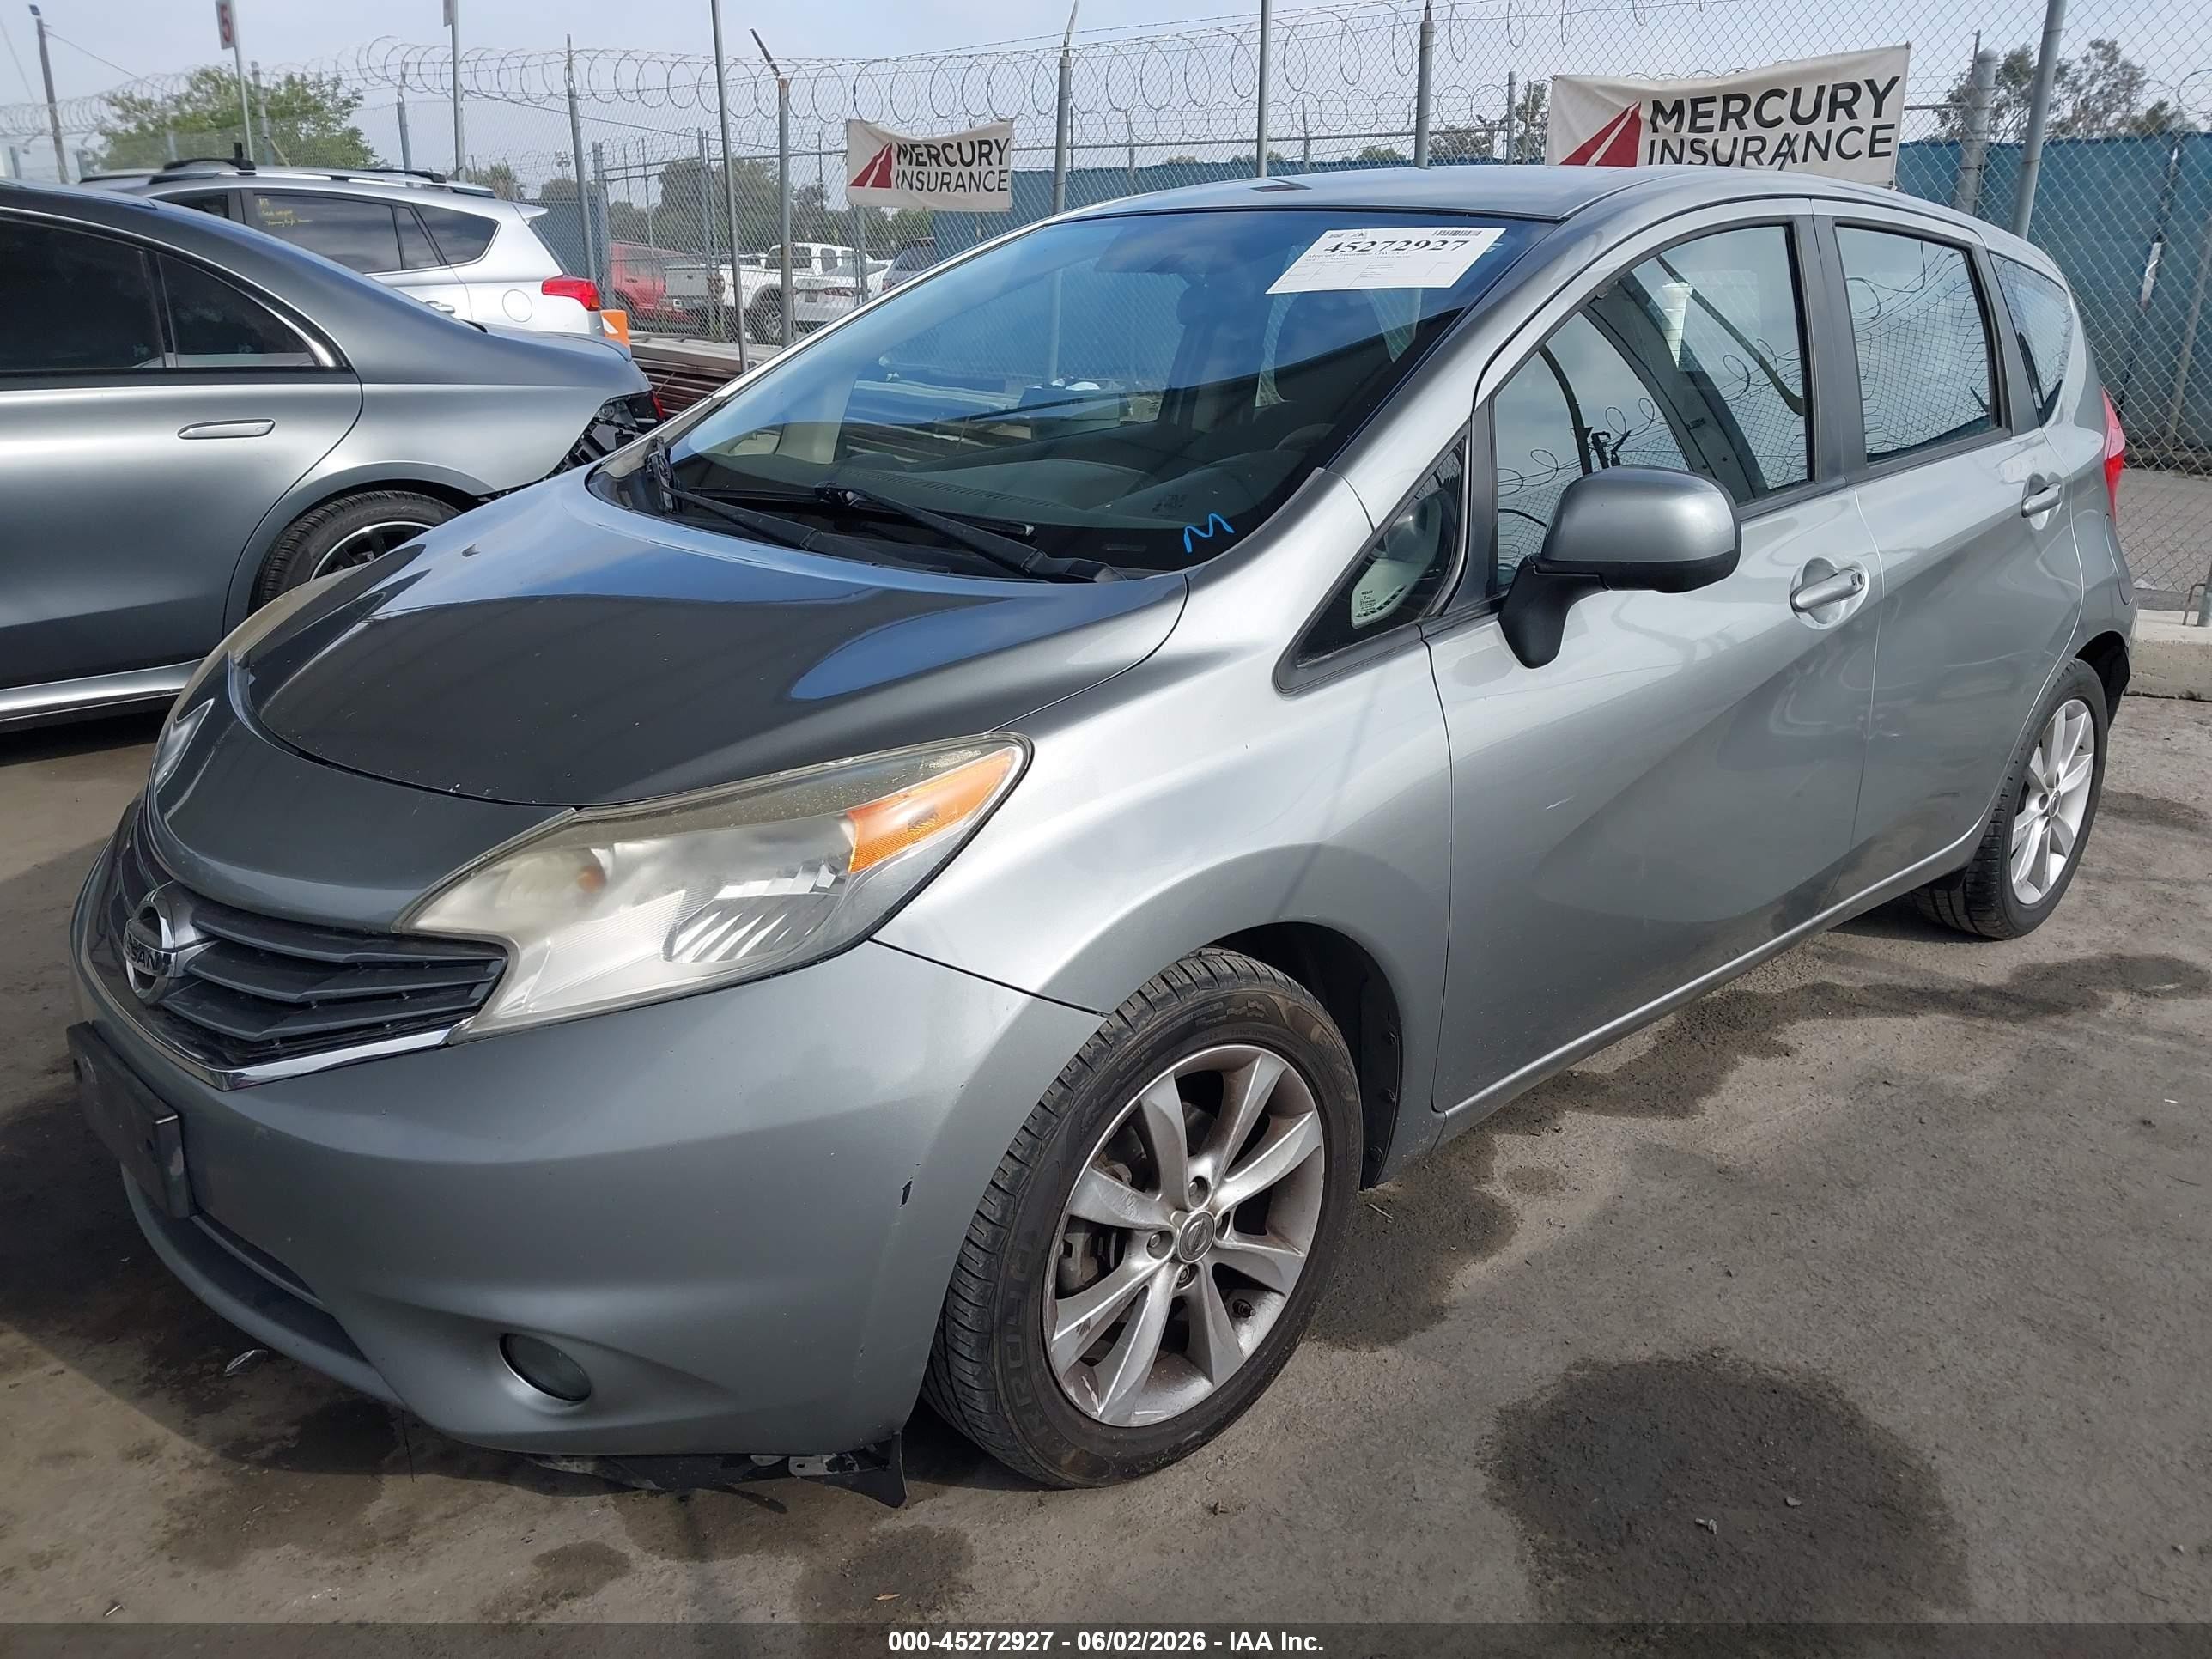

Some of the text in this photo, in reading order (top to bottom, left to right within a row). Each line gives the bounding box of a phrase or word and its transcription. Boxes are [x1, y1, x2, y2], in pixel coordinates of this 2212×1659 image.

[1650, 76, 1901, 134] MERCURY
[896, 137, 1010, 167] MERCURY
[1648, 124, 1896, 167] INSURANCE
[895, 169, 1009, 192] INSURANCE
[1323, 240, 1470, 253] 45272927
[1184, 513, 1235, 554] M
